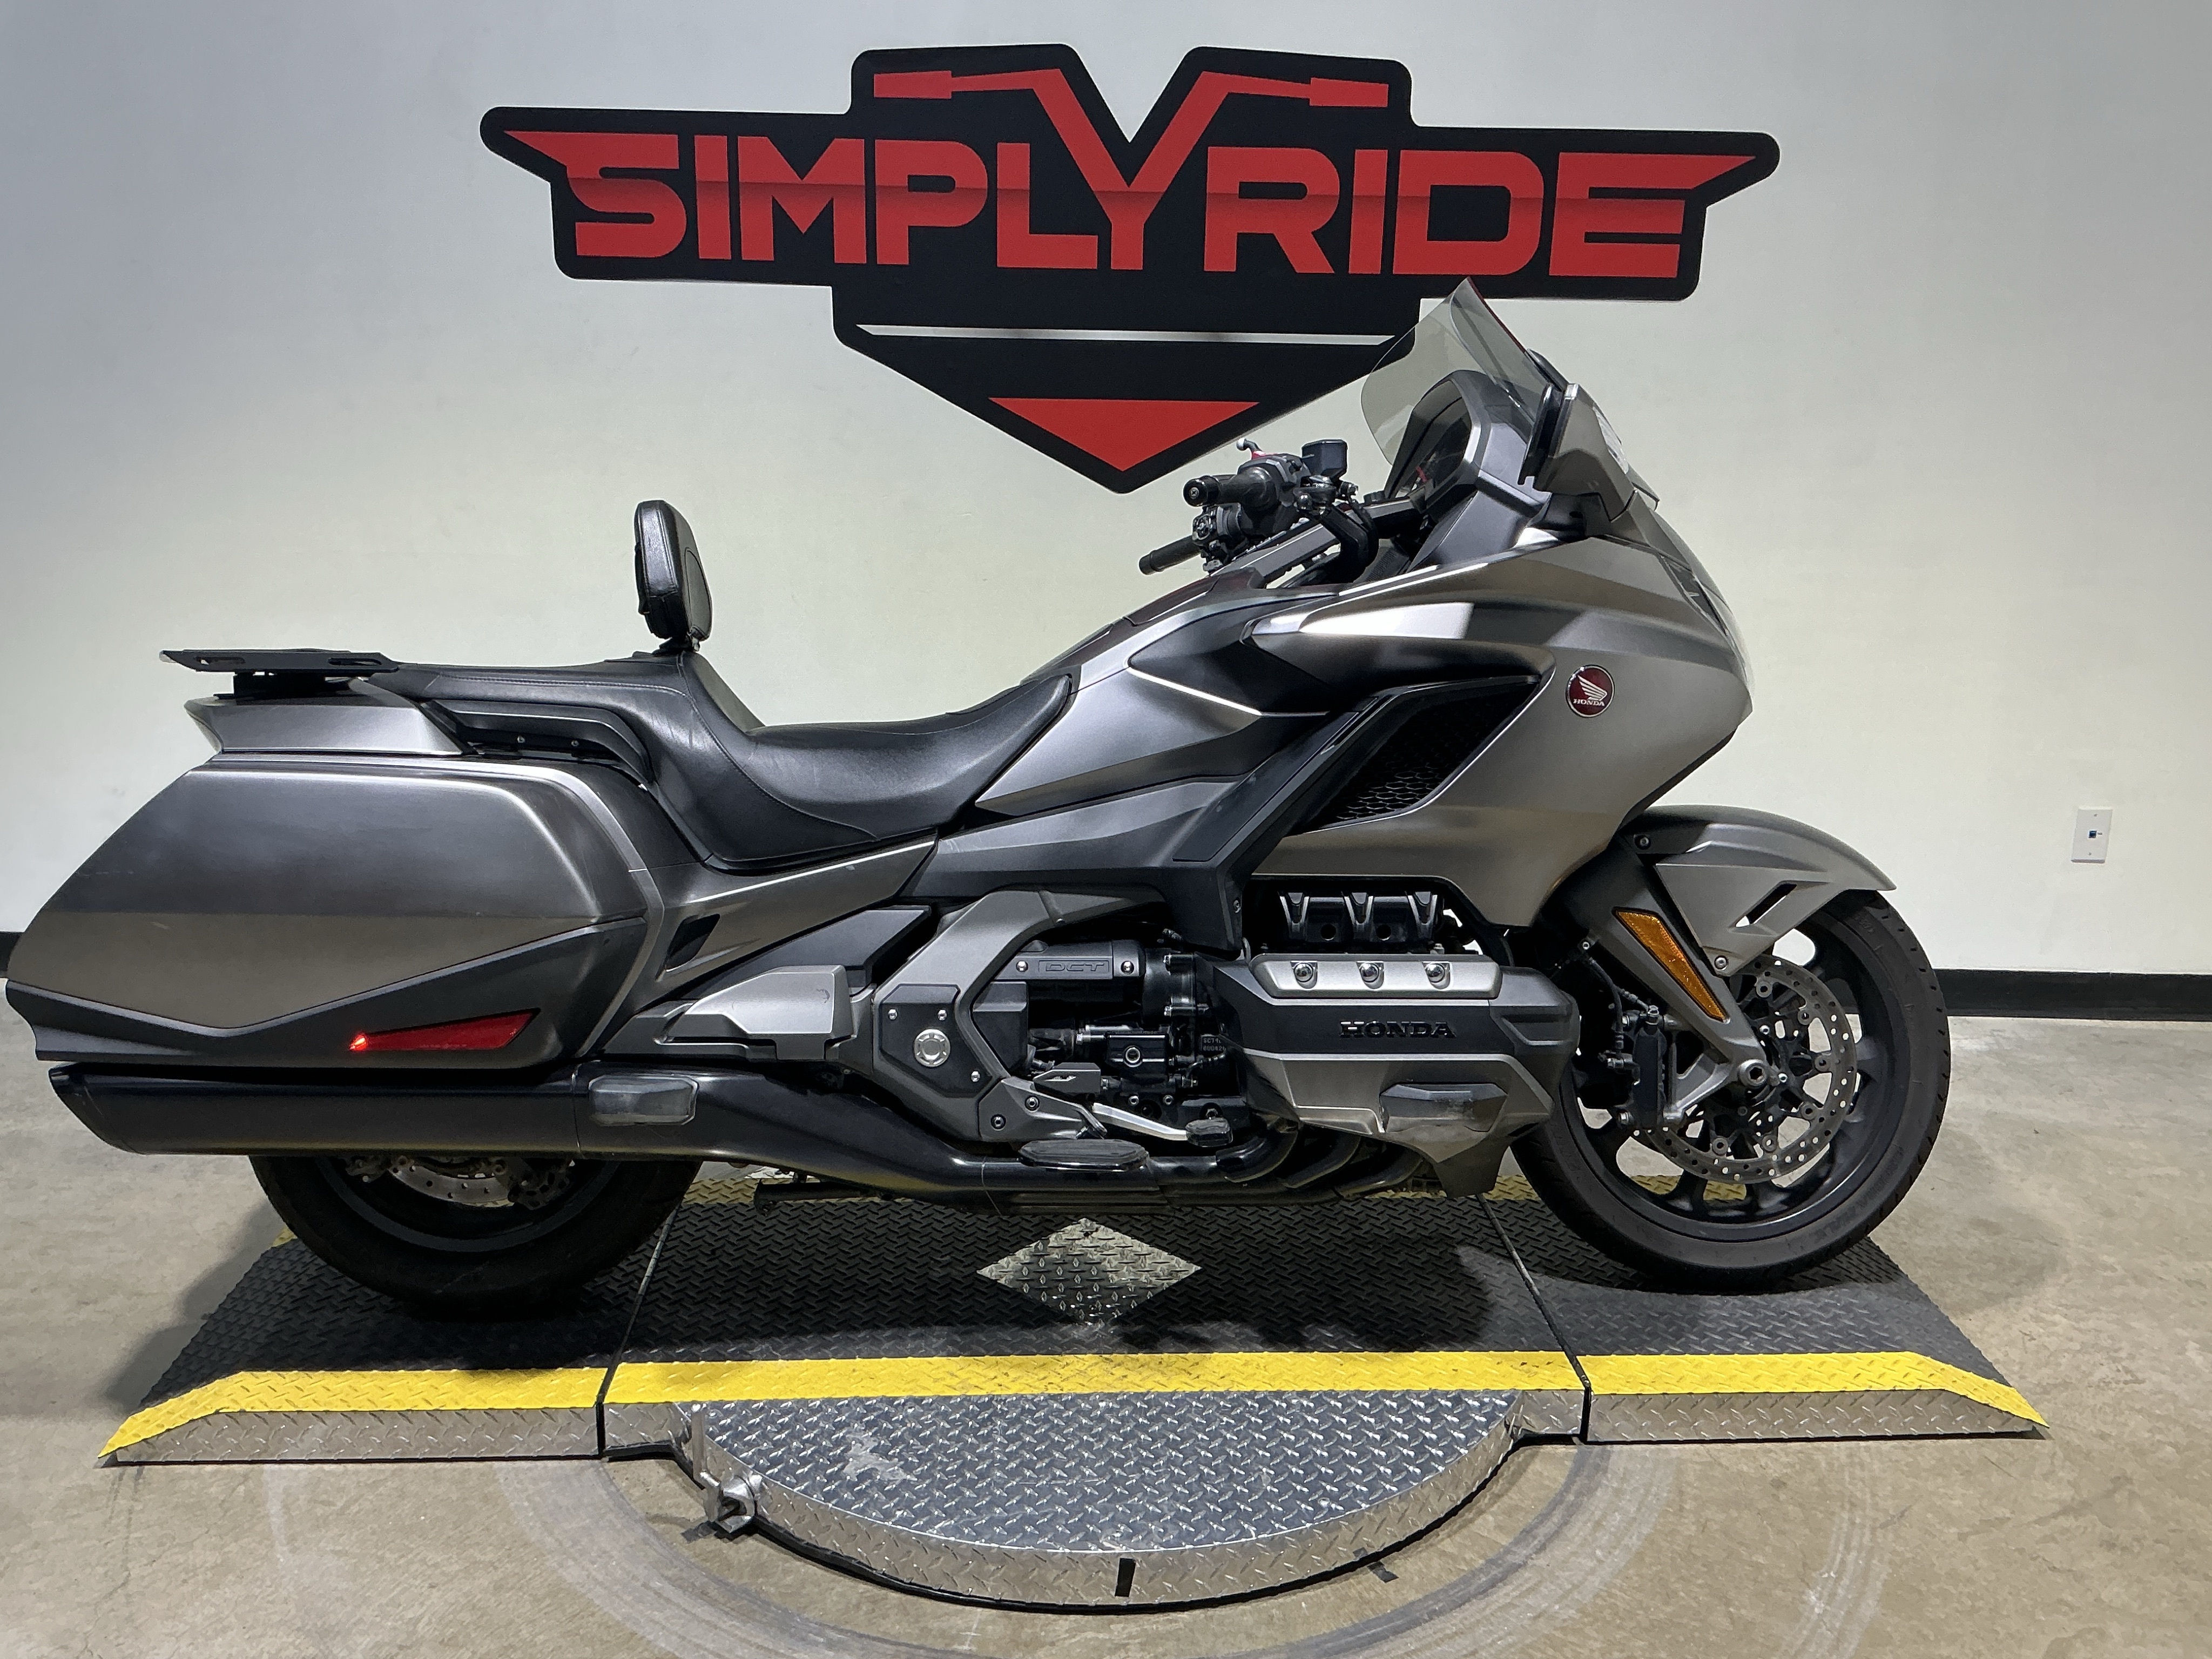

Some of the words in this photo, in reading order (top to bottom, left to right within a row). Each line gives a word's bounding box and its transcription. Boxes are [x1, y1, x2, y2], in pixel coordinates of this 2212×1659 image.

[505, 69, 1756, 278] SIMPLYRIDE
[1045, 962, 1104, 972] DCT
[1339, 1021, 1456, 1037] HONDA
